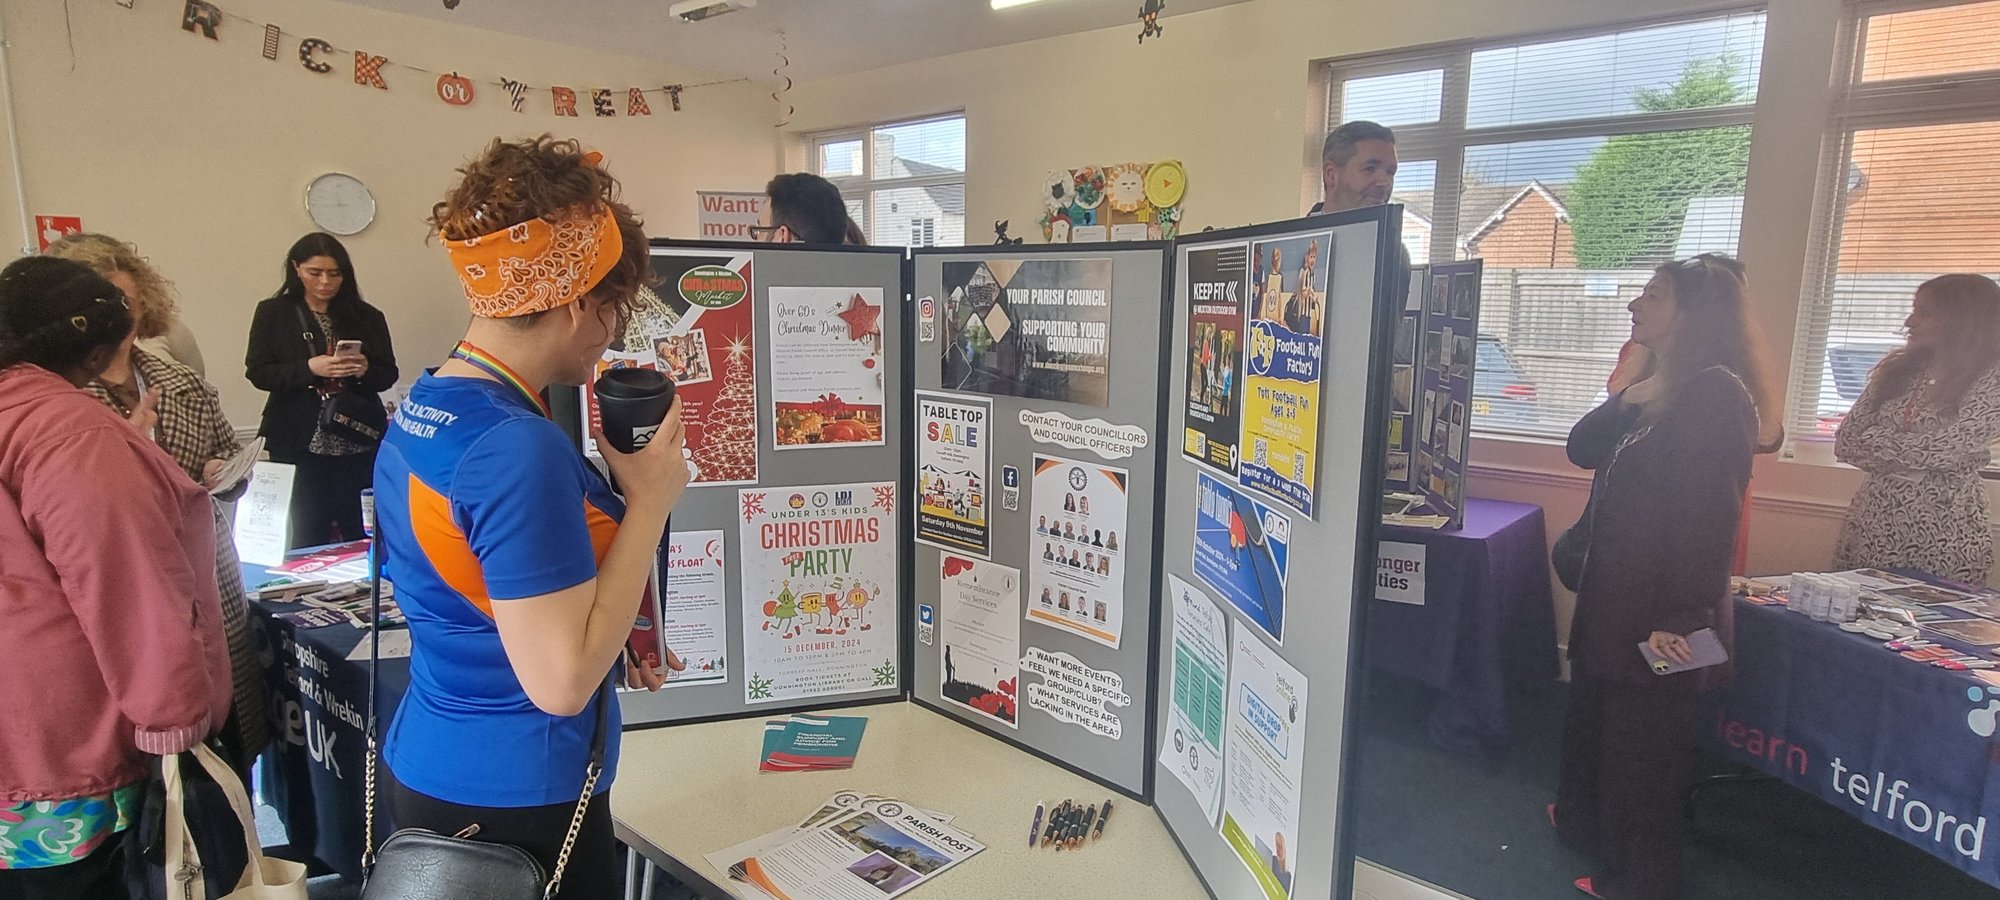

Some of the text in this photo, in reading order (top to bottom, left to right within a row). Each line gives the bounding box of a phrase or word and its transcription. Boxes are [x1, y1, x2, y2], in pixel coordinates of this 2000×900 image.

[501, 77, 684, 117] TREAT
[702, 195, 759, 213] Want
[1007, 288, 1107, 307] YOUR PARISH COUNCIL
[1193, 283, 1226, 301] KEEP FIT
[778, 320, 817, 336] Christmas
[1022, 319, 1106, 339] SUPPORTING YOUR
[1047, 336, 1105, 355] COMMUNITY
[1276, 338, 1306, 357] Football
[1287, 358, 1313, 376] Factory
[1272, 390, 1298, 408] Football
[923, 405, 983, 423] TABLE TOP
[927, 421, 978, 449] SALE
[1022, 413, 1146, 444] CONTACT YOUR COUNCILLORS
[1033, 428, 1131, 455] AND COUNCIL OFFICERS
[772, 506, 868, 519] UNDER 13'S KIDS
[1201, 480, 1216, 519] table
[1215, 489, 1232, 530] tennis
[761, 517, 880, 550] CHRISTMAS
[921, 515, 946, 529] Saturday
[956, 523, 985, 537] November
[677, 558, 704, 569] FLOAT
[790, 548, 852, 578] PARTY
[1377, 557, 1420, 574] onger
[957, 579, 1001, 598] Remembrance
[959, 591, 971, 603] Day
[971, 595, 997, 608] Services
[784, 645, 792, 653] 15
[841, 639, 861, 649] 2024
[1028, 661, 1130, 705] FEEL WE NEED A SPECIFIC
[1036, 651, 1121, 689] WANT MORE EVENTS?
[1275, 671, 1294, 695] Telford
[1046, 679, 1103, 707] GROUP/CLUB?
[314, 683, 324, 705] &
[323, 688, 366, 732] Wrekin
[1030, 696, 1120, 739] LACKING IN THE AREA?
[1037, 687, 1120, 727] WHAT SERVICES ARE
[1246, 693, 1282, 733] DIGITAL DROP
[1247, 706, 1279, 744] IN SUPPORT
[304, 709, 344, 780] UK
[1716, 711, 1808, 775] learn
[1831, 757, 1987, 861] telford
[902, 815, 974, 853] PARISH POST
